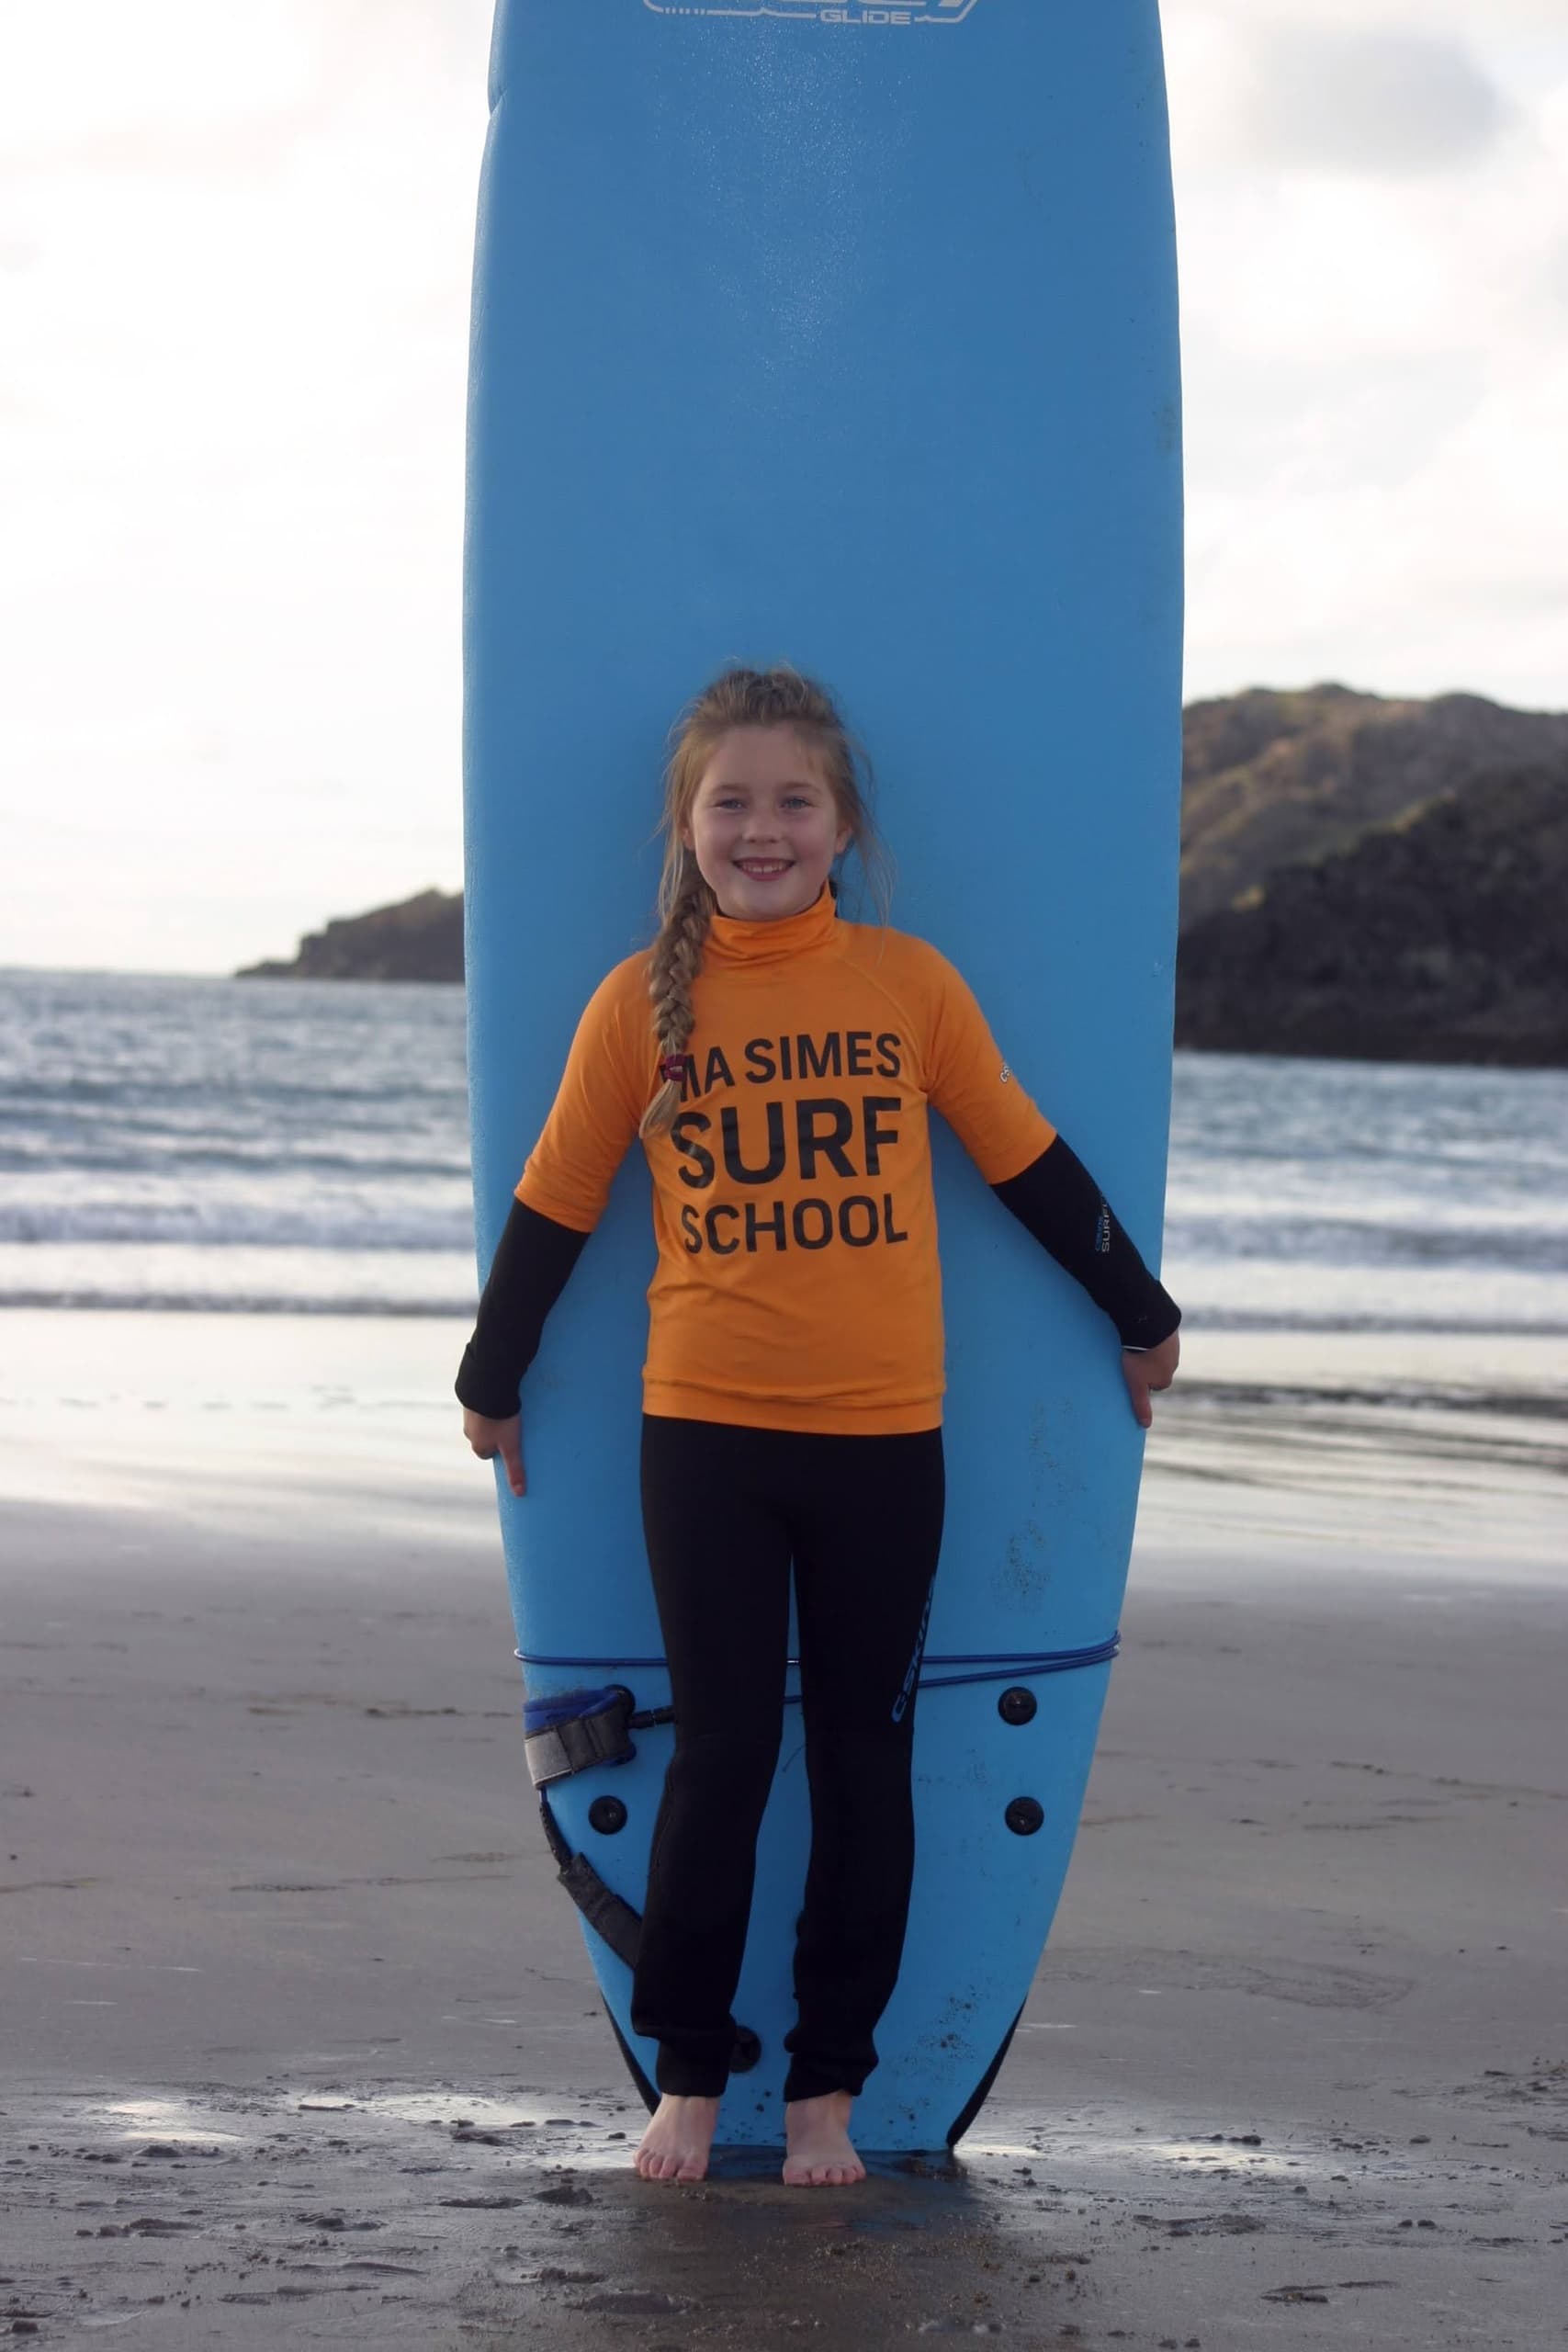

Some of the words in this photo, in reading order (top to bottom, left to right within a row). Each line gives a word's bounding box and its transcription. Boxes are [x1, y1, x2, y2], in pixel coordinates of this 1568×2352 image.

[820, 9, 911, 25] GLIDE
[744, 1031, 902, 1084] SIMES
[670, 1096, 902, 1189] SURF
[681, 1193, 908, 1255] SCHOOL
